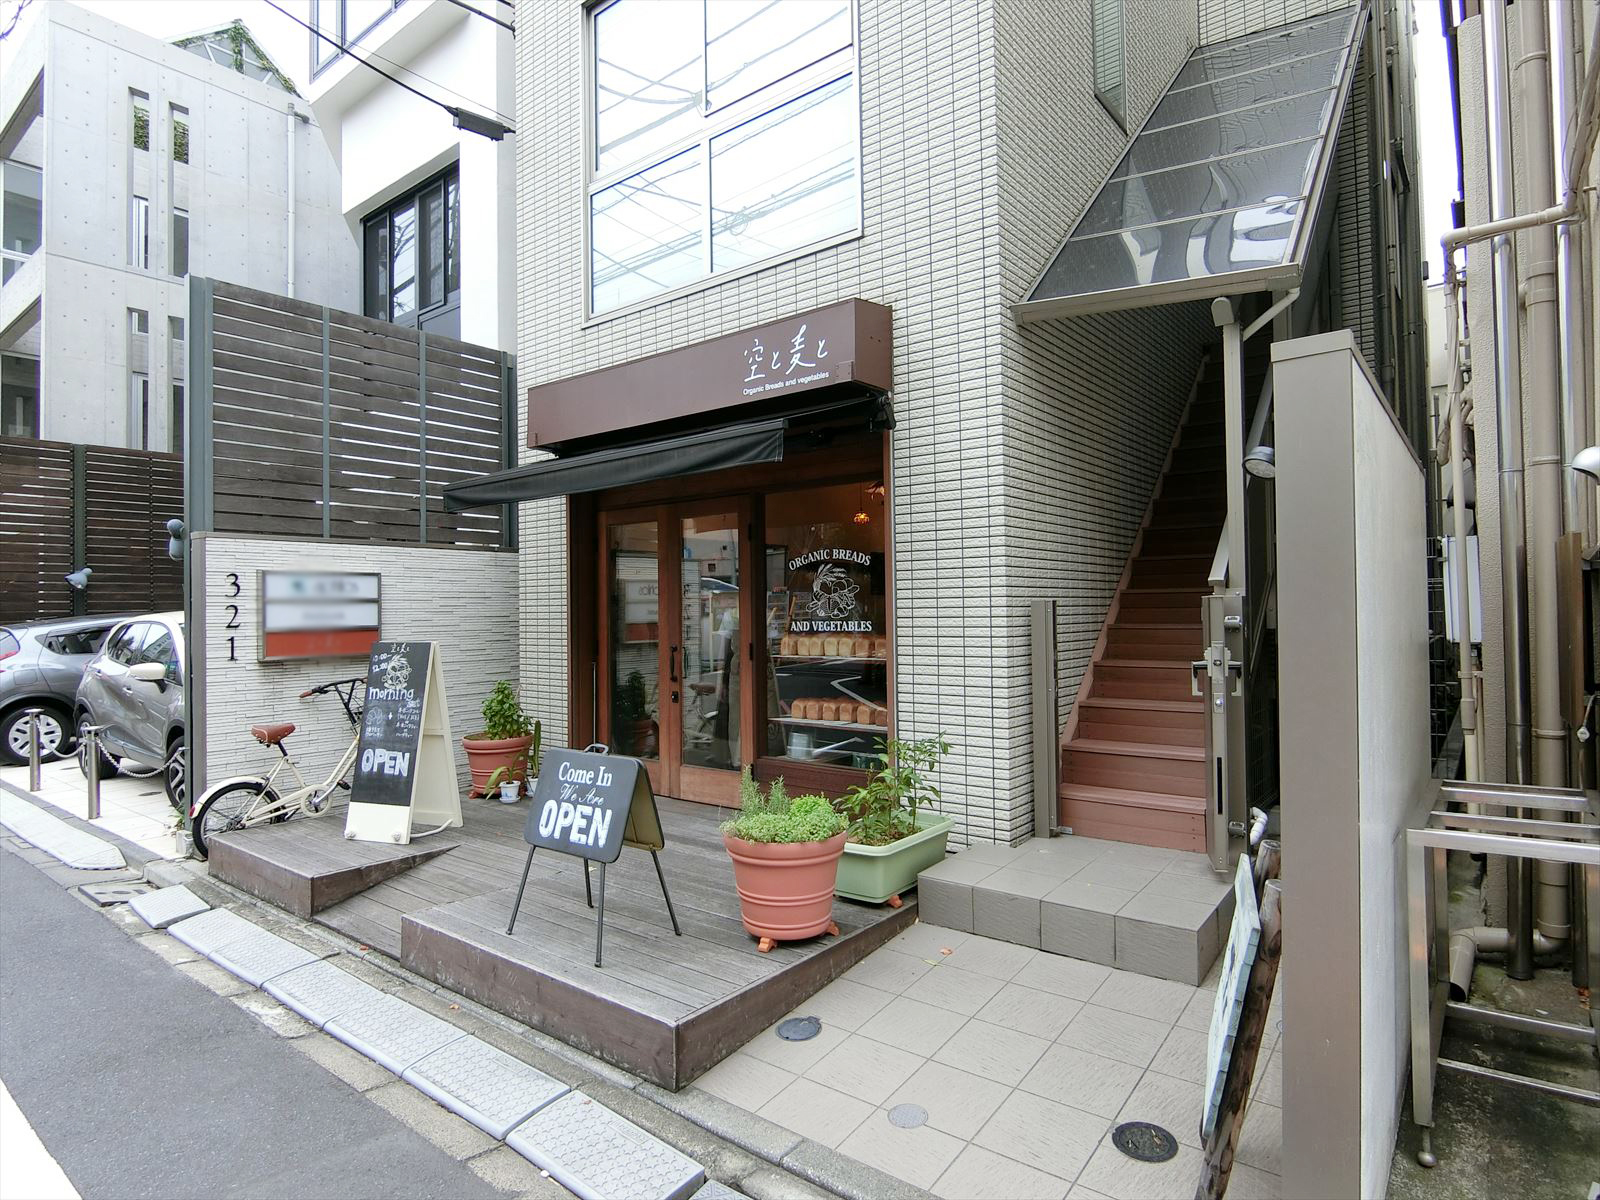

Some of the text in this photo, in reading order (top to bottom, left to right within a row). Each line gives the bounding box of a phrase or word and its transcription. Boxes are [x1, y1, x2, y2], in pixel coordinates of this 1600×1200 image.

[743, 324, 828, 382] 空と麦と
[743, 371, 830, 396] Organic Breads and vegetables
[788, 548, 872, 571] ORGANIC BREADS
[225, 573, 241, 598] 3
[225, 605, 241, 629] 2
[790, 620, 873, 632] AND VEGETABLES
[227, 636, 239, 662] 1
[368, 686, 415, 701] morning
[361, 748, 411, 777] OPEN
[558, 761, 613, 787] Come In
[559, 782, 605, 806] We Are
[538, 799, 613, 849] OPEN
